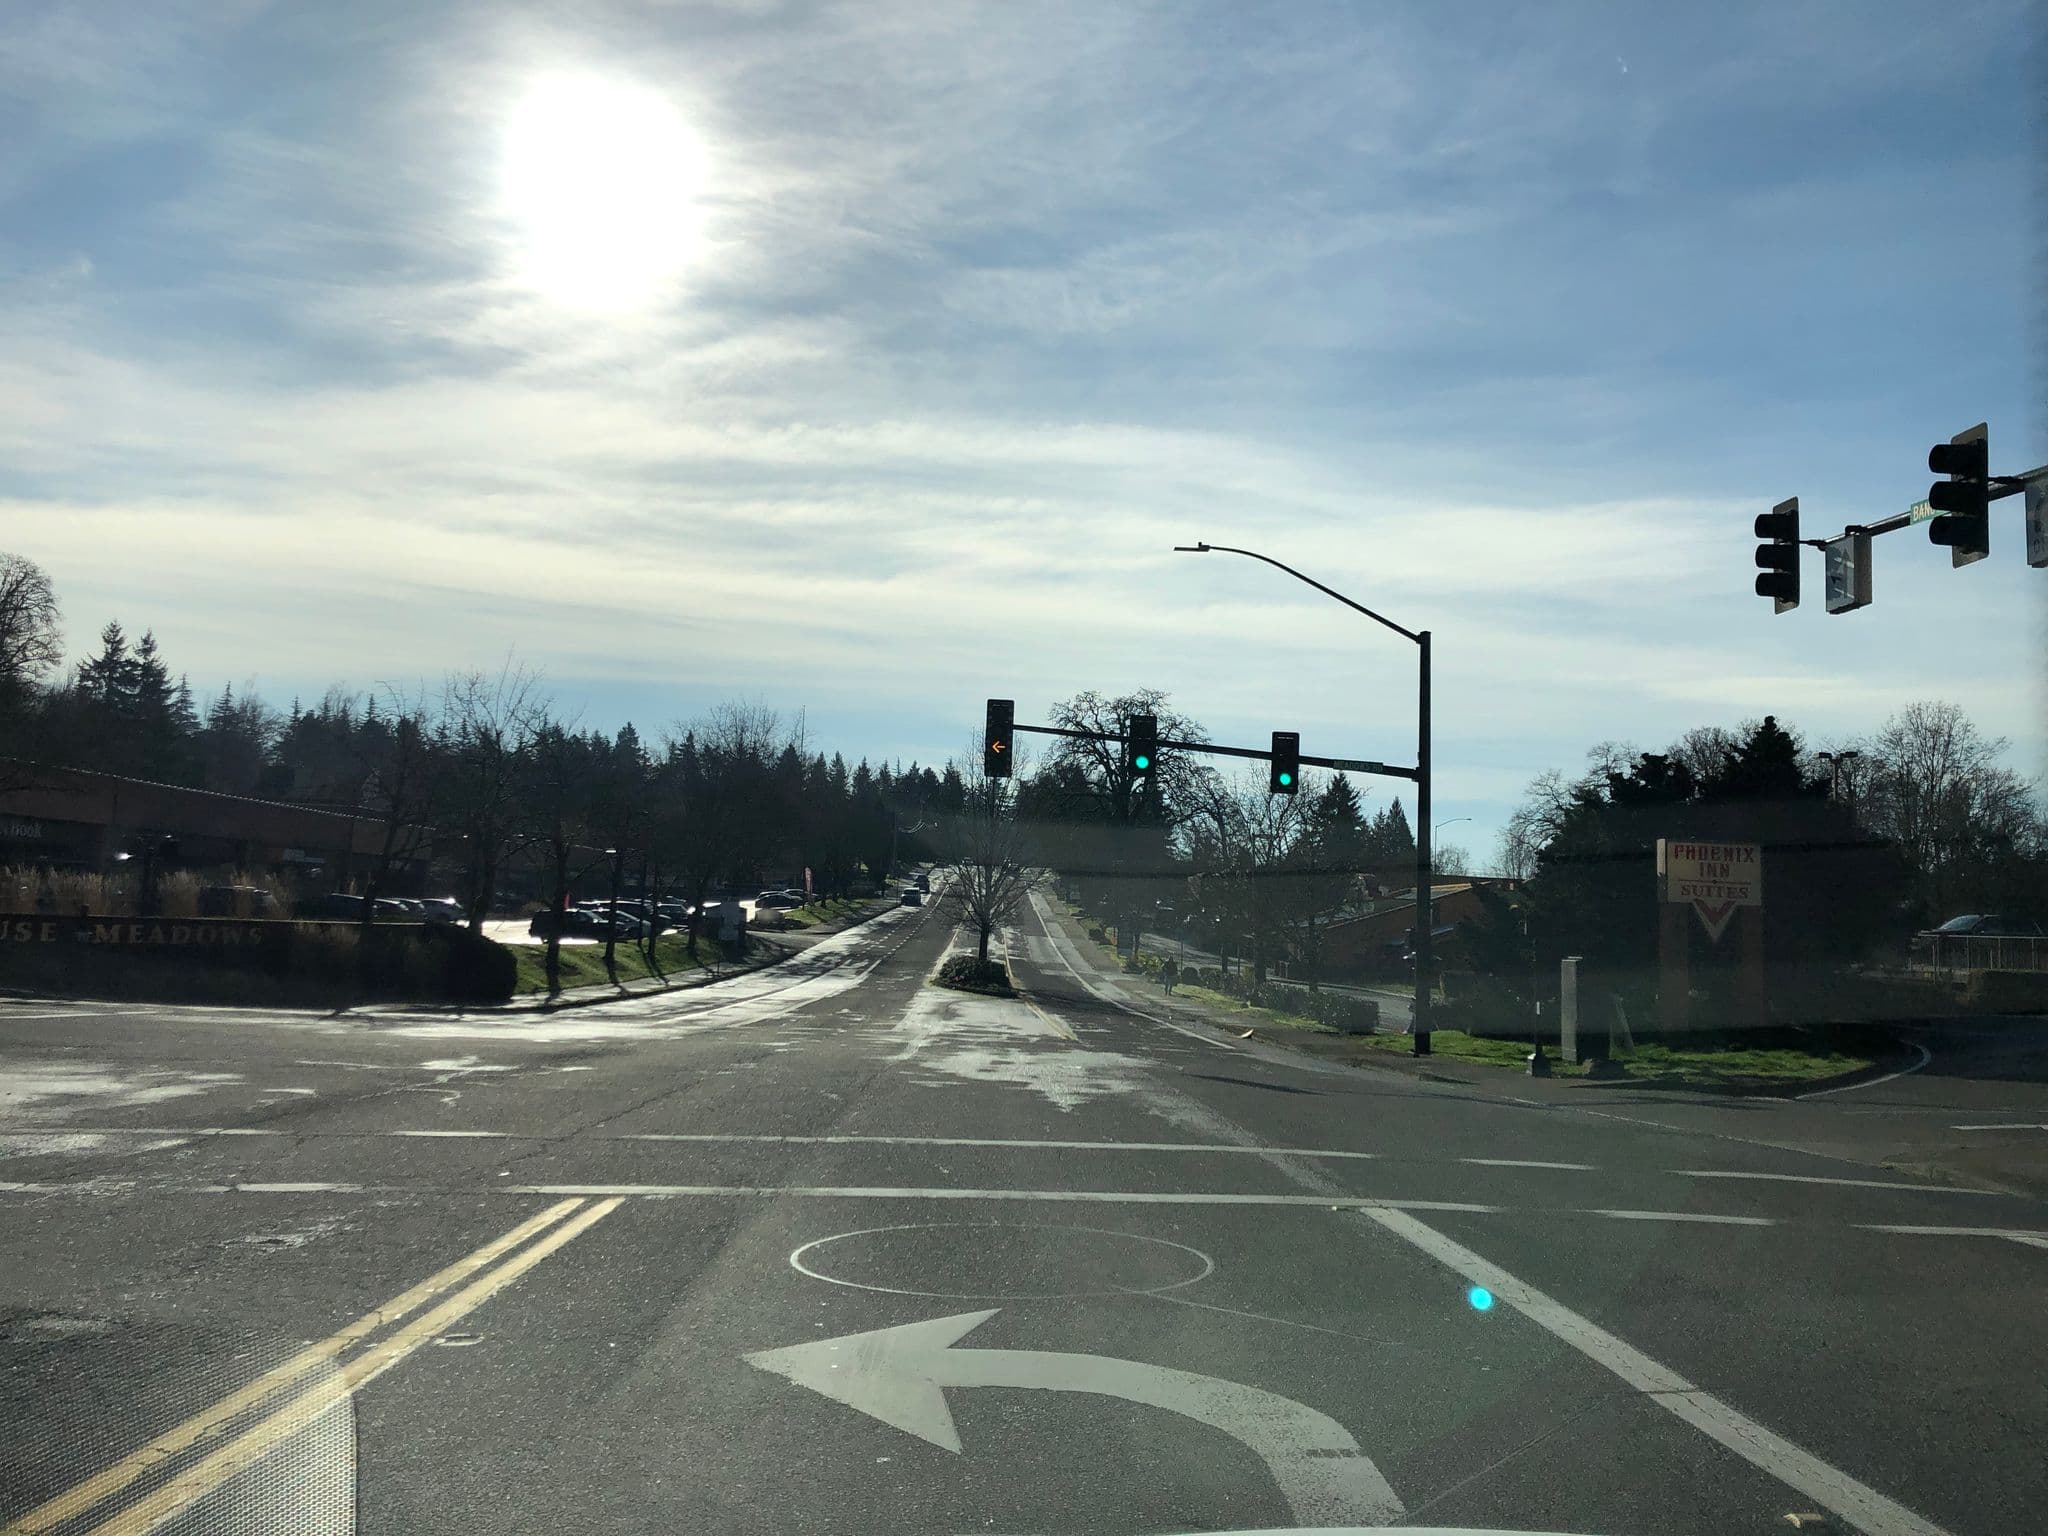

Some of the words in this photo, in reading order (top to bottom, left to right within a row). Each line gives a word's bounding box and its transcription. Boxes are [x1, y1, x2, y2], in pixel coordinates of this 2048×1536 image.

[1674, 844, 1755, 863] PHOENIX
[1699, 862, 1730, 878] INN
[1680, 884, 1749, 899] SUITES
[95, 923, 265, 945] MEADOWS
